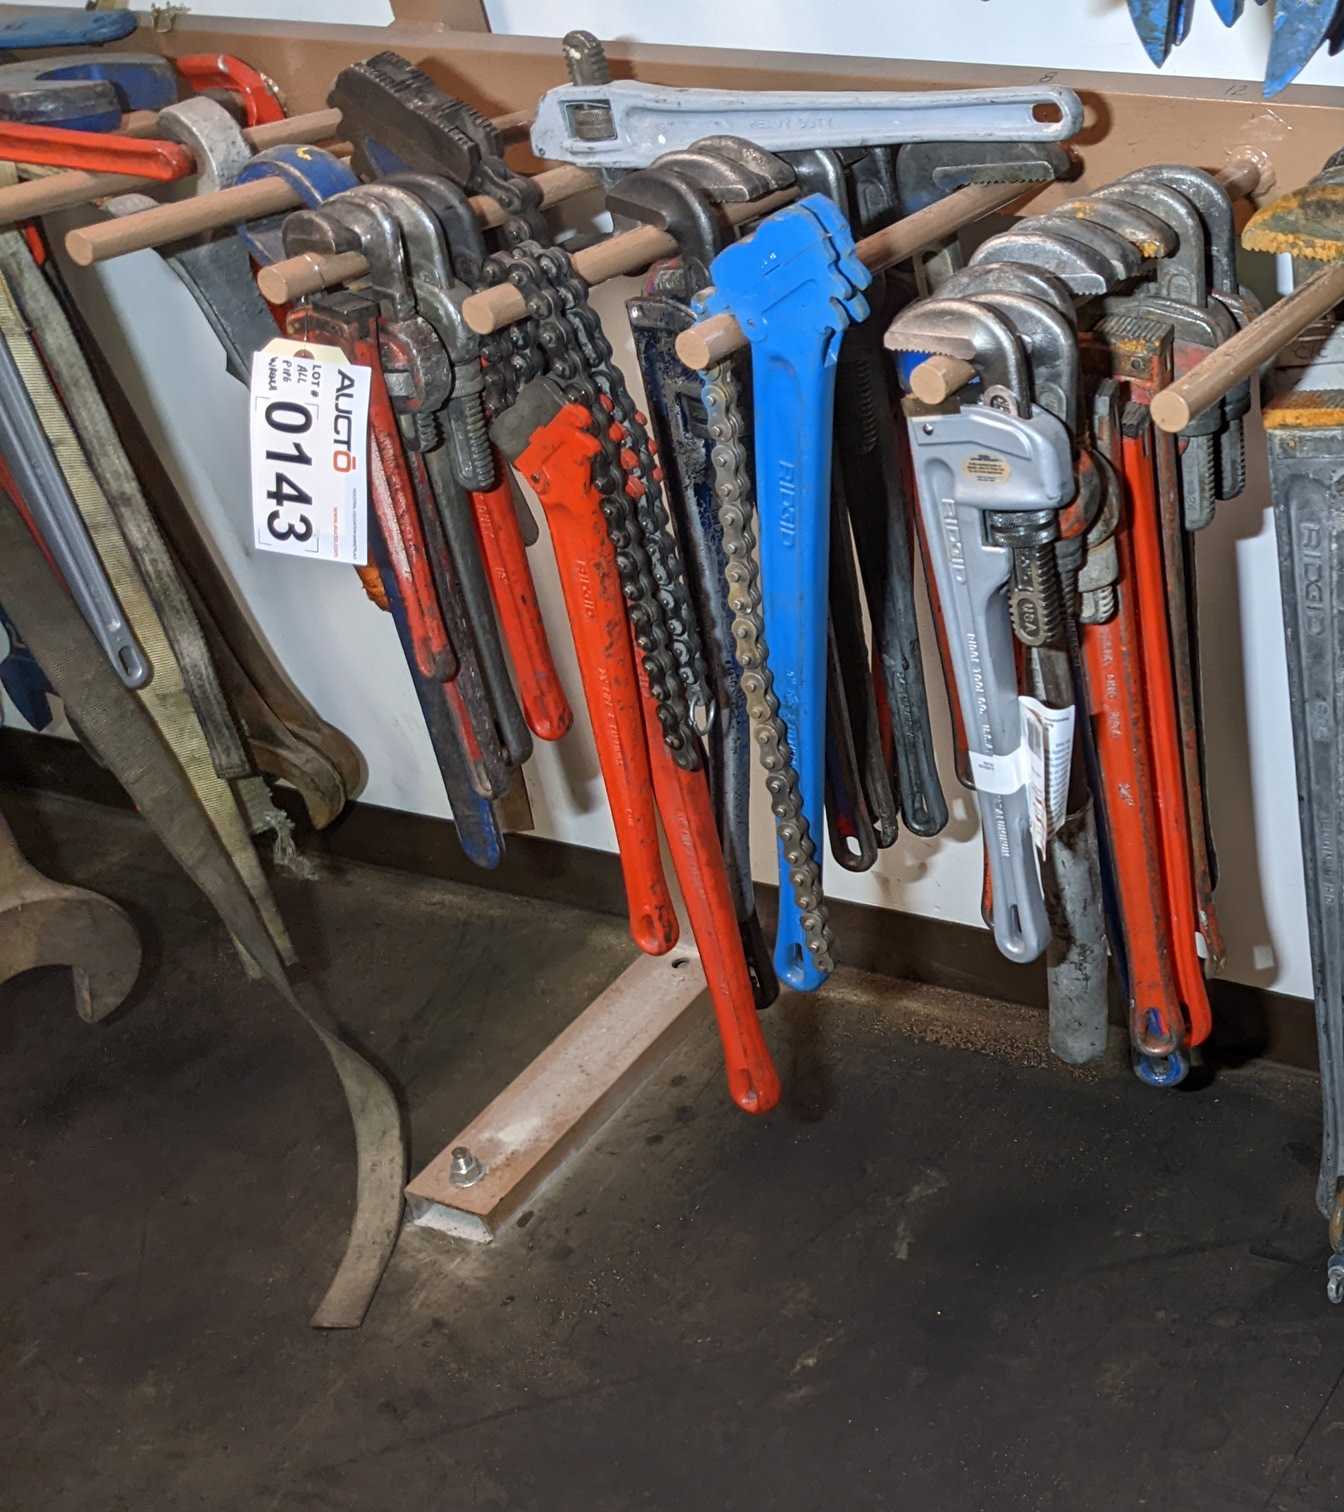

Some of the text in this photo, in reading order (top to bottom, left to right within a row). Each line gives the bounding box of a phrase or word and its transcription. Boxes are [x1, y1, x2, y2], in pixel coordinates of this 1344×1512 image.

[296, 364, 310, 384] ALL
[310, 364, 322, 398] LOT #
[264, 400, 314, 543] 0143
[940, 497, 966, 585] RIDGID
[1301, 522, 1323, 637] RIDGID
